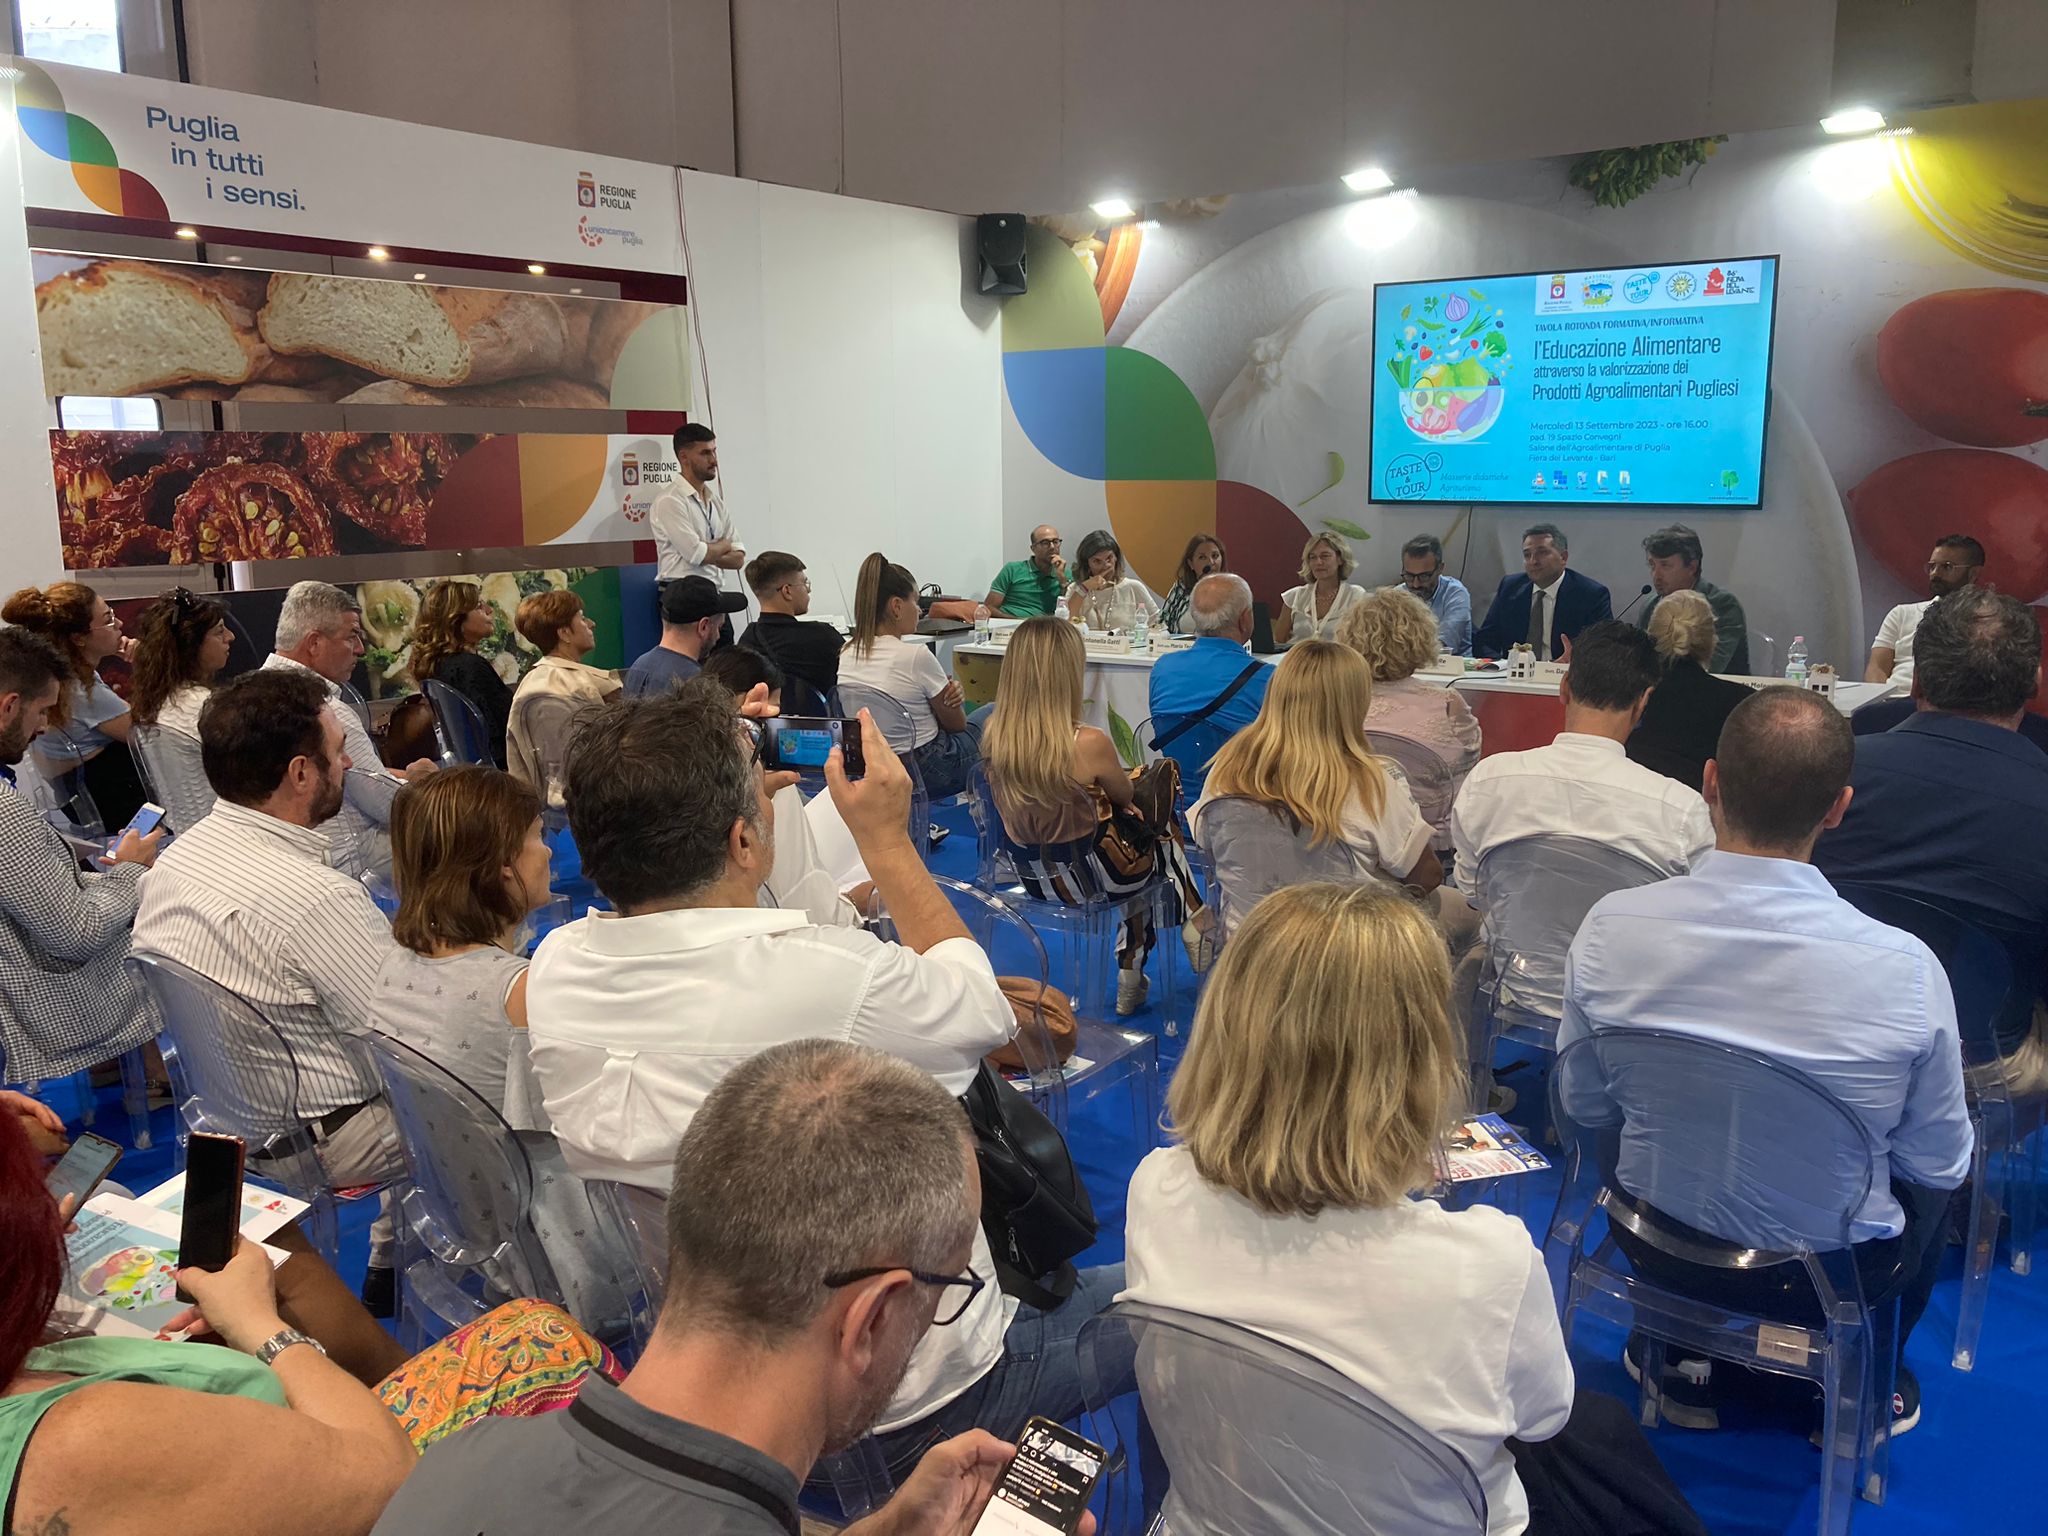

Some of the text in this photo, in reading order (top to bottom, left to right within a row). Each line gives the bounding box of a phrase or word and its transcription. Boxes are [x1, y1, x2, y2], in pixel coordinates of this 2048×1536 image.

[146, 106, 240, 142] Puglia
[171, 142, 264, 176] in tutti
[206, 177, 305, 210] i sensi.
[600, 185, 636, 199] REGIONE
[600, 197, 631, 210] PUGLIA
[588, 227, 635, 237] unioncamere
[622, 237, 643, 246] puglia
[1535, 316, 1704, 332] TAVOLA ROTONDA FORMATIVA/INFORMATIVA
[1534, 336, 1721, 360] l'Educazione Alimentare
[1534, 359, 1689, 378] attraverso la valorizzazione dei
[1533, 378, 1739, 402] Prodotti Agroalimentari Pugliesi
[1575, 422, 1584, 430] 13
[1586, 421, 1634, 430] Settembre
[1636, 421, 1659, 429] 2023
[1684, 420, 1709, 429] 16.00
[1557, 434, 1582, 442] Spazio
[1584, 433, 1621, 442] Convegni
[1644, 444, 1671, 452] Puglia
[643, 462, 677, 471] REGIONE
[1389, 462, 1422, 478] TASTE
[643, 474, 672, 483] PUGLIA
[1395, 481, 1425, 497] TOUR
